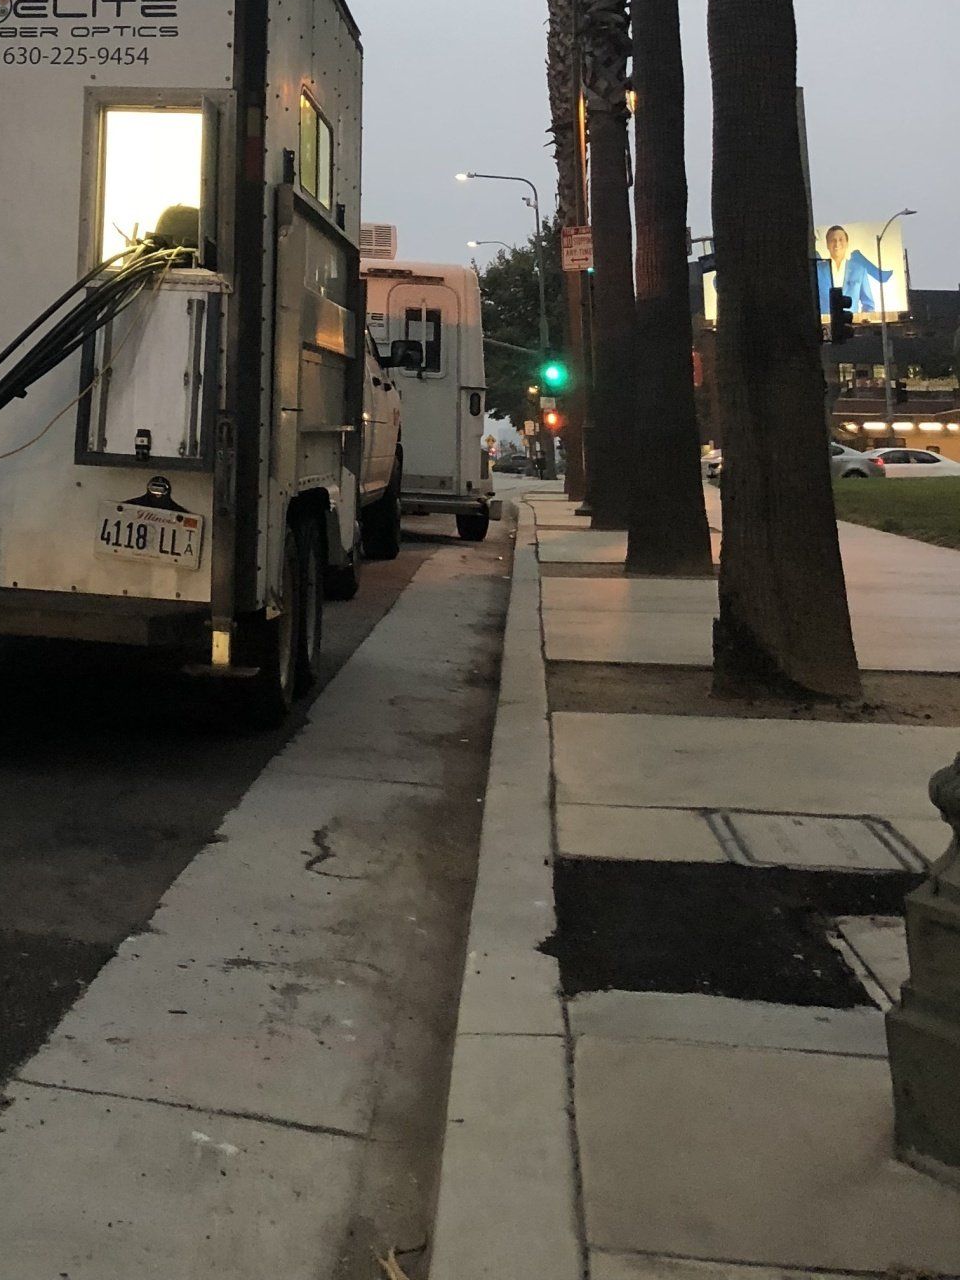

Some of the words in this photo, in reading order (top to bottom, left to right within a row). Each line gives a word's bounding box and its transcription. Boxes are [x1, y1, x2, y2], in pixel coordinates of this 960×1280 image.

[70, 26, 179, 38] OPTICS
[3, 46, 150, 66] 630-225-9454
[100, 518, 148, 550] 4118
[159, 526, 182, 557] LL
